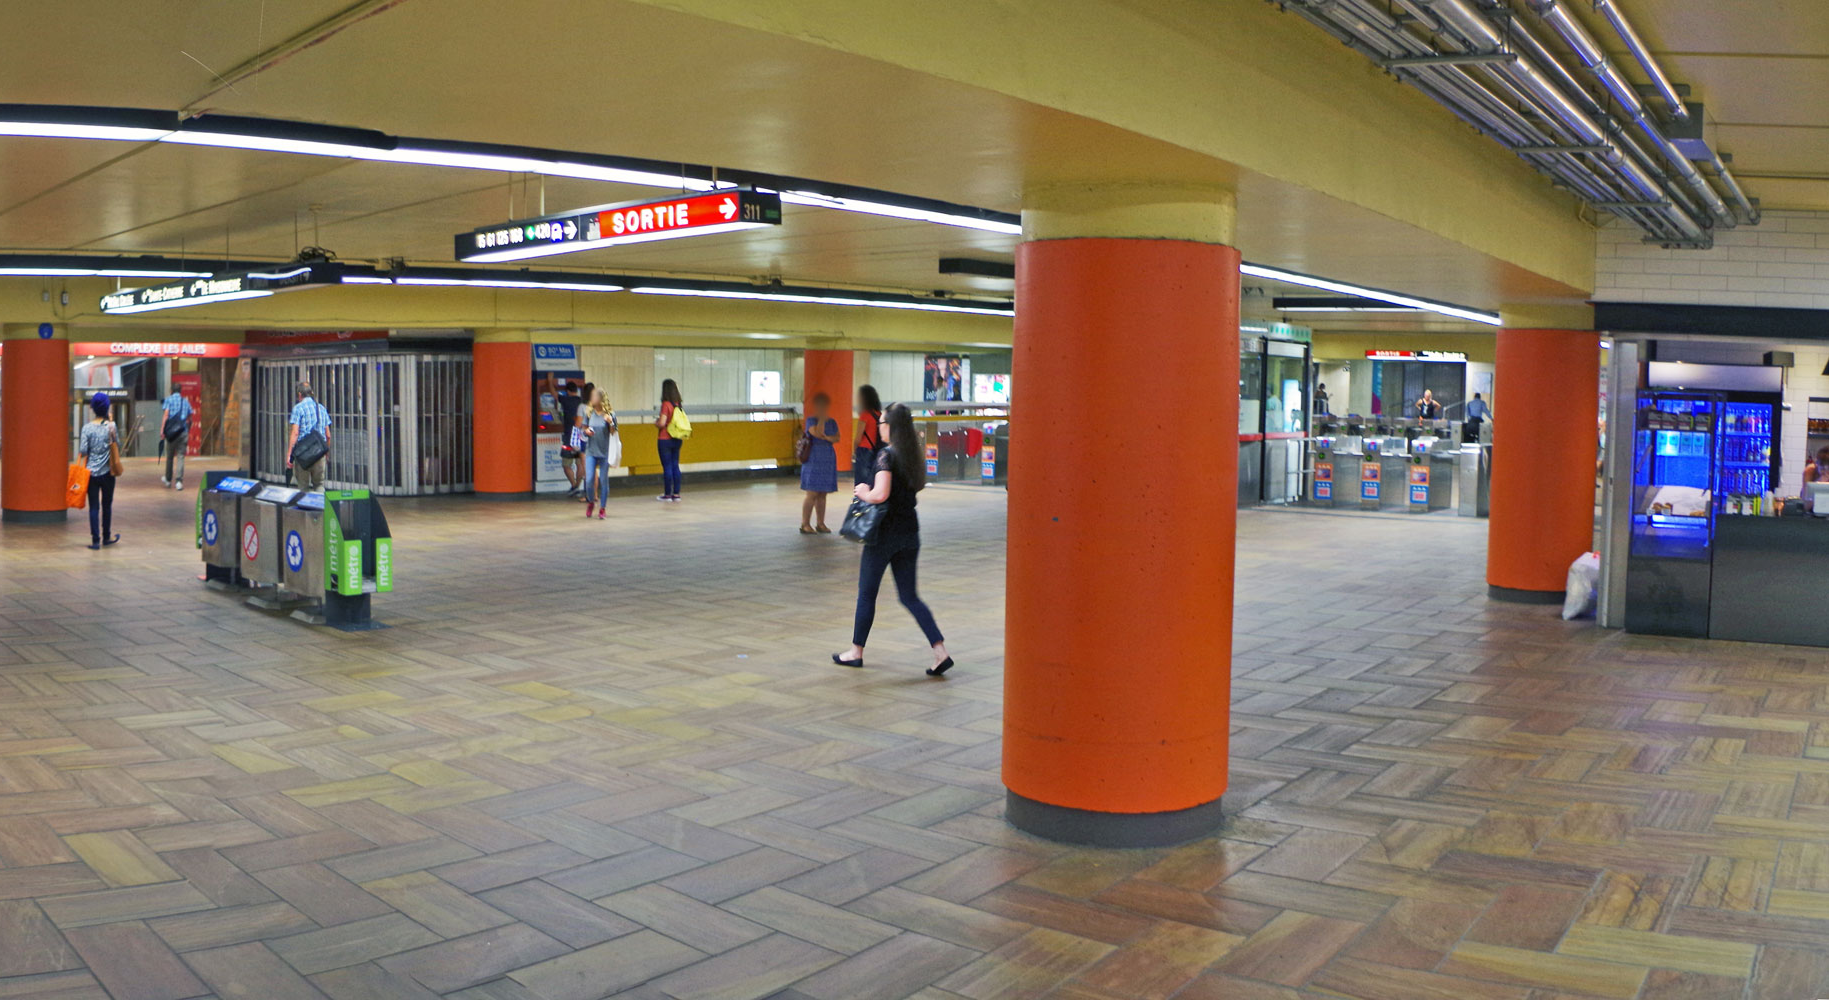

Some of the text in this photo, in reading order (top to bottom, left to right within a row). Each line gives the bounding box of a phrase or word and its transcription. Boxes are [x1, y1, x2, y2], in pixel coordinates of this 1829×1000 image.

[612, 203, 689, 234] SORTIE
[744, 203, 760, 220] 311
[486, 233, 495, 247] 61
[110, 343, 206, 355] COMPLEXE LES AILES
[348, 545, 359, 589] métro
[378, 543, 389, 587] métro
